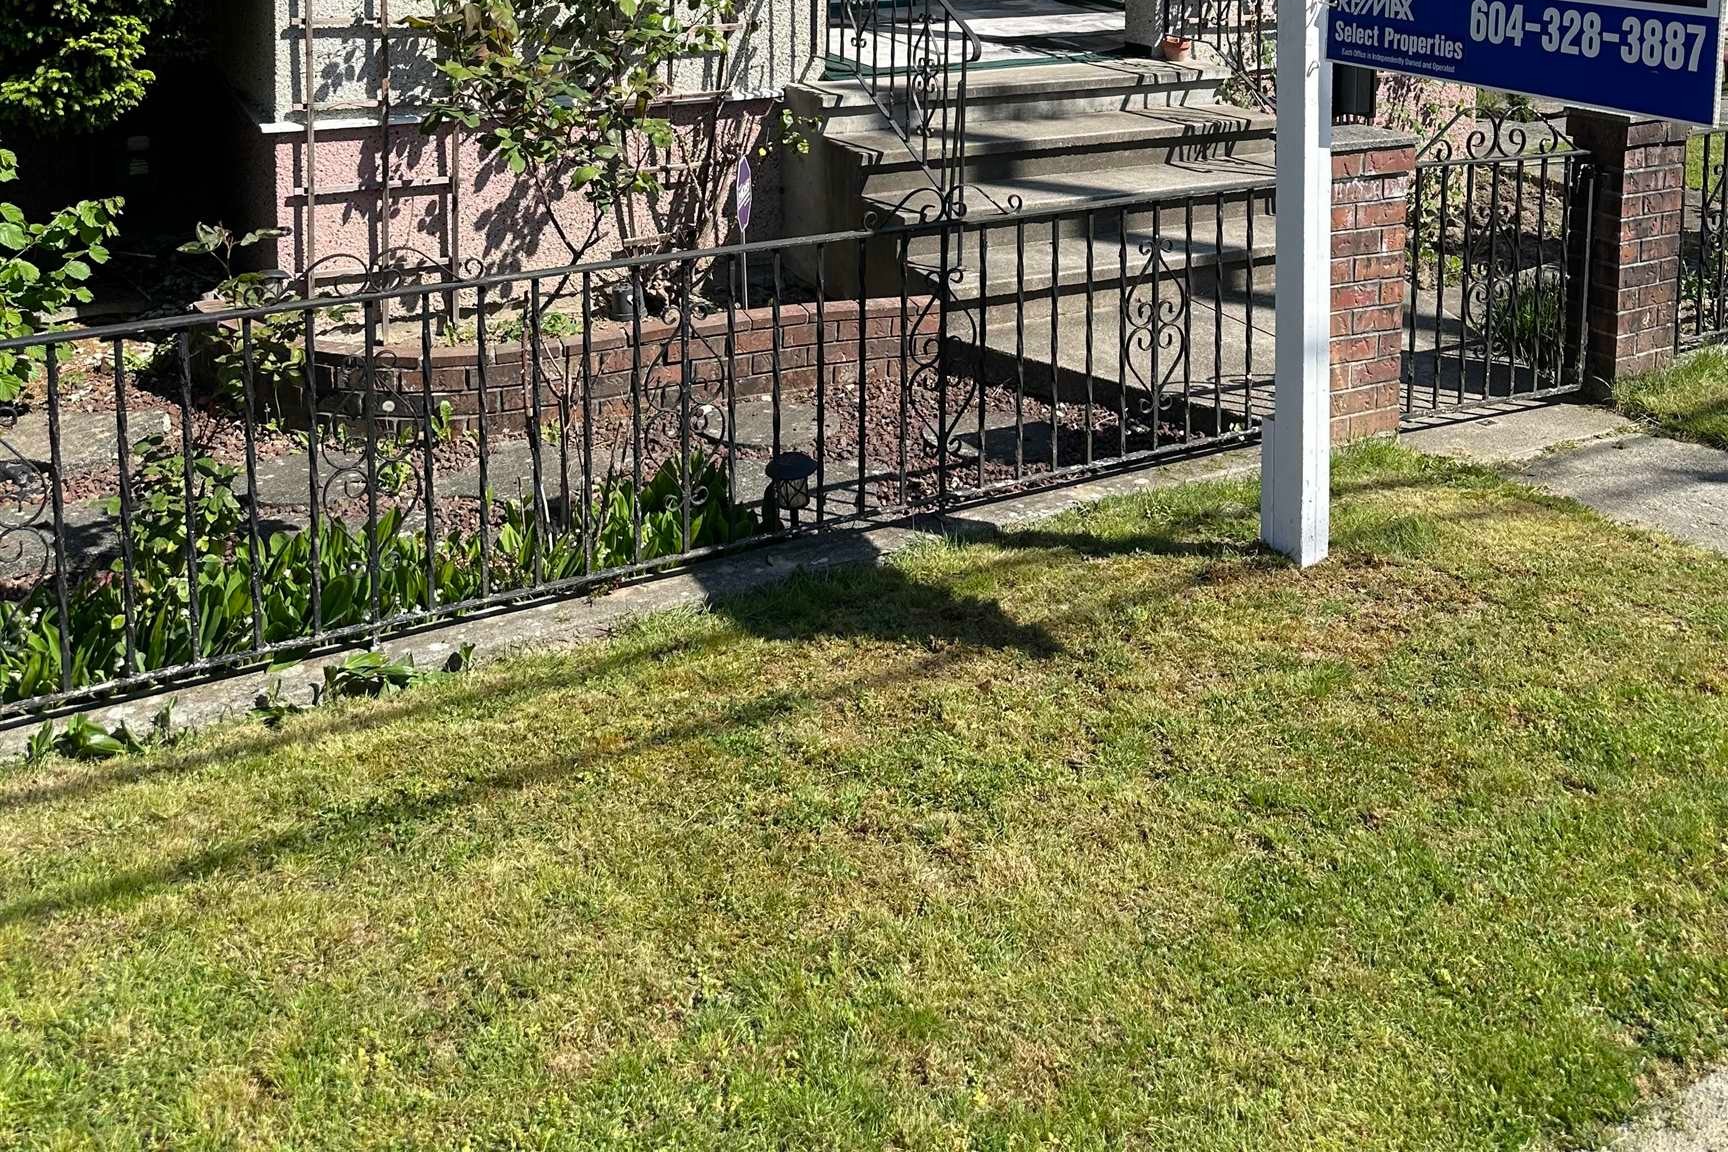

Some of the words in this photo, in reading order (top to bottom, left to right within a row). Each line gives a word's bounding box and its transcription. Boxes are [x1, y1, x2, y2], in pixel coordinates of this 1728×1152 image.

[1335, 20, 1379, 47] Select
[1384, 27, 1463, 60] Properties
[1353, 49, 1366, 59] Office
[1372, 52, 1404, 66] Independently
[1422, 60, 1431, 69] and
[1432, 61, 1455, 73] Operated
